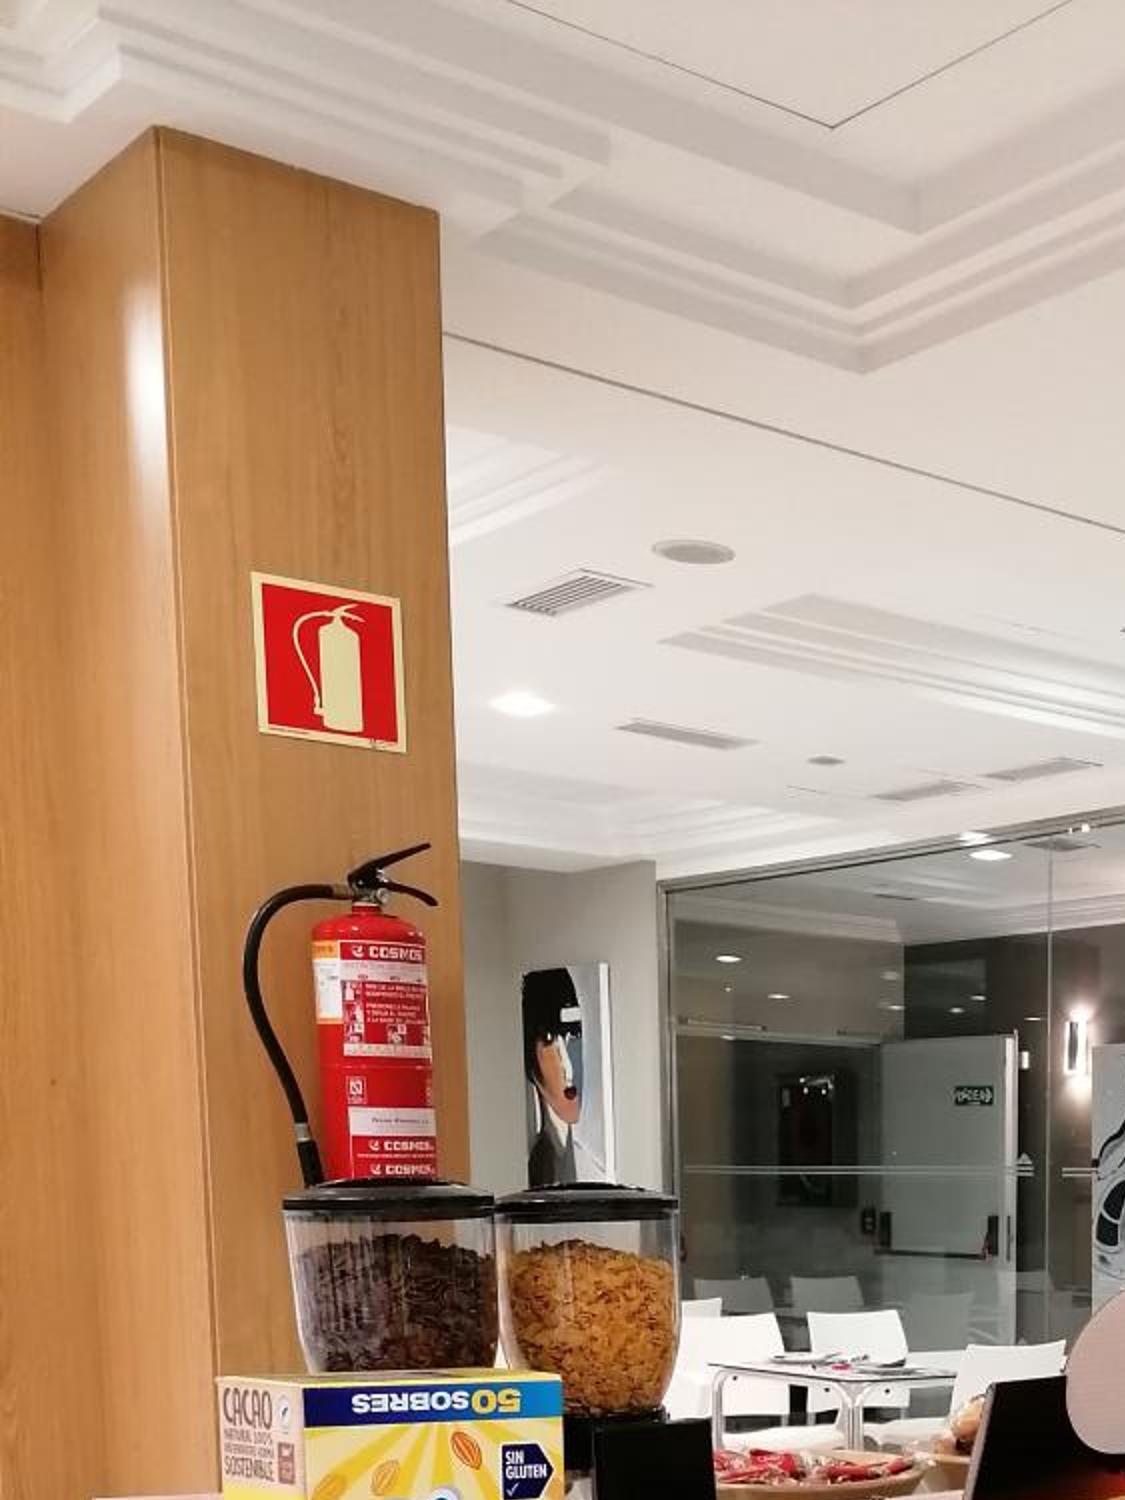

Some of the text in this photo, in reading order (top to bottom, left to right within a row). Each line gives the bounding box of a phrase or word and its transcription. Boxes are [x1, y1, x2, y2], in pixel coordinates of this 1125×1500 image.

[369, 945, 423, 961] COSMOS
[223, 1387, 273, 1430] CACAO
[351, 1391, 470, 1414] SOBRES
[505, 1450, 524, 1465] SIN
[505, 1463, 548, 1480] GLUTEN
